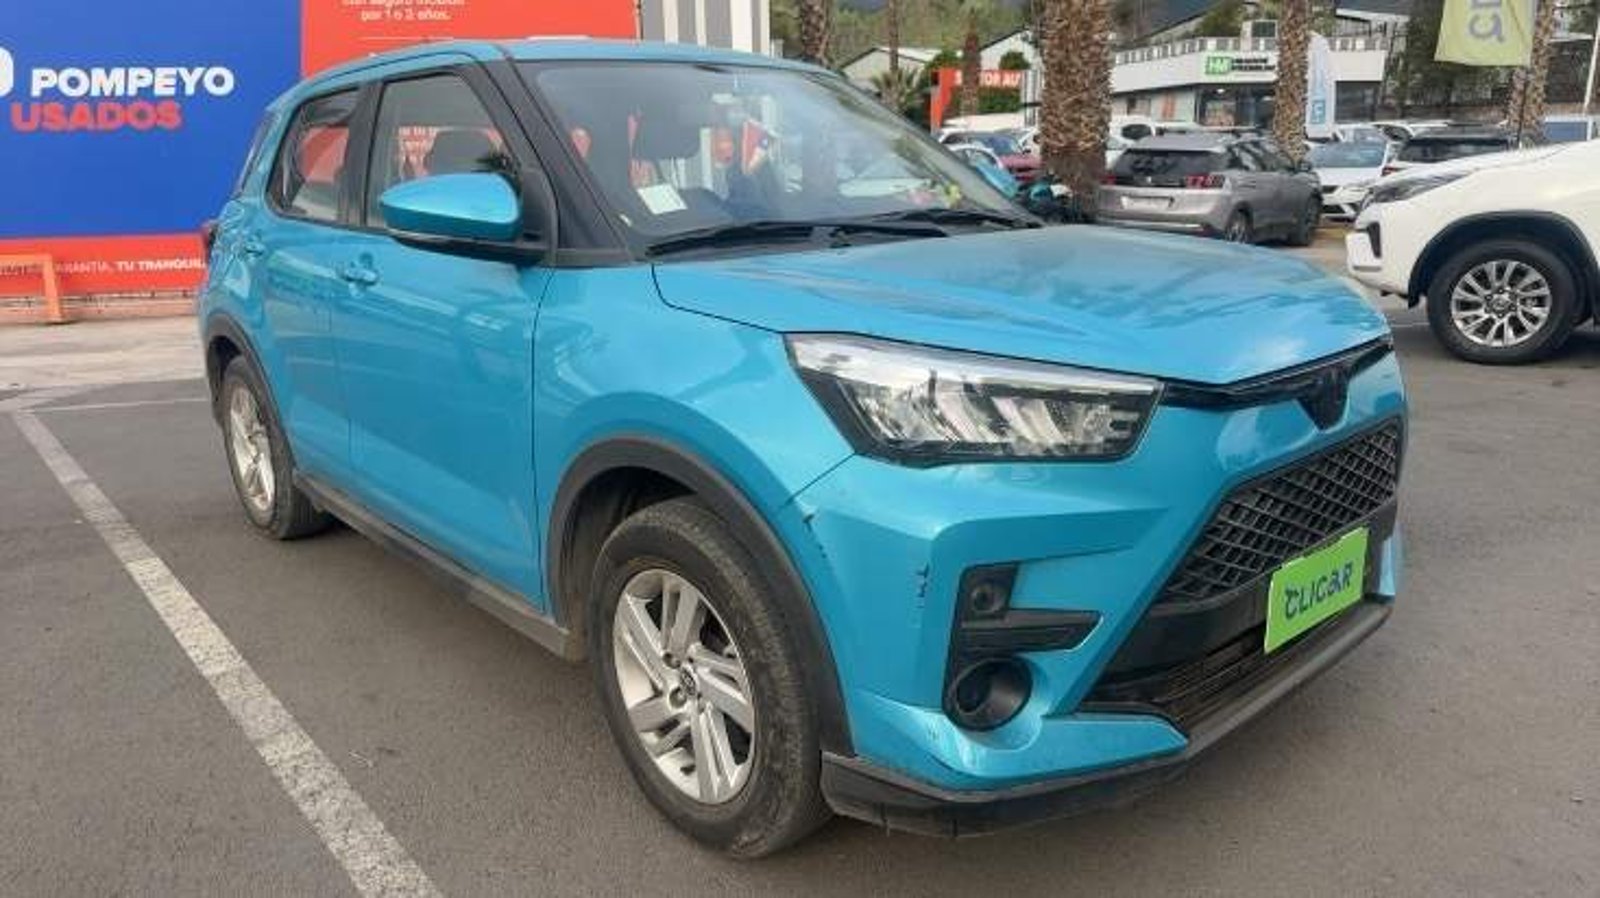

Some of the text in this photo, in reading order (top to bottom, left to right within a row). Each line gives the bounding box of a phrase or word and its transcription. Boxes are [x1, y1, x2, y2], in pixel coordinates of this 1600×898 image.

[31, 66, 235, 97] POMPEYO
[11, 101, 182, 132] USADOS
[117, 260, 135, 272] TU
